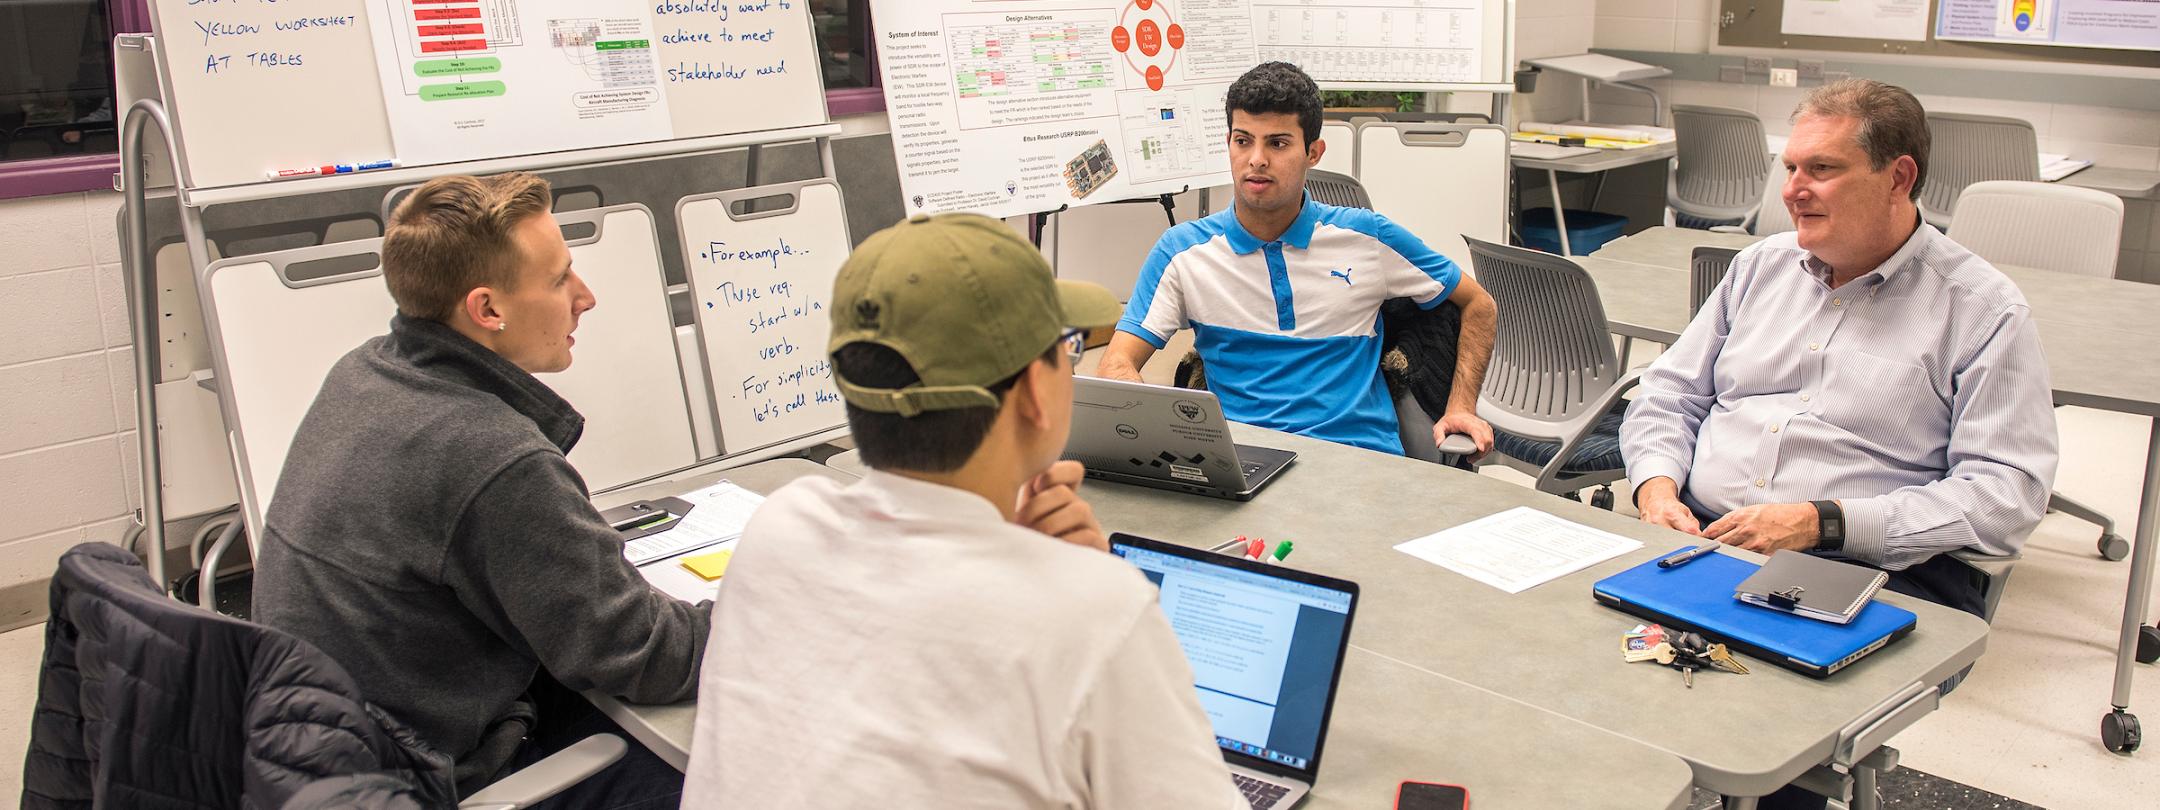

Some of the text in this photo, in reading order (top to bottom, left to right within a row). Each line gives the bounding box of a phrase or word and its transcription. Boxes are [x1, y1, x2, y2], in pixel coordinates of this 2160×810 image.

[656, 0, 790, 21] absolutely want to
[1006, 15, 1023, 23] Design
[194, 15, 356, 46] YELLOW WORKSHEET
[662, 27, 775, 44] achieve to meet
[888, 31, 910, 39] System
[206, 52, 303, 74] AT TABLES
[667, 60, 787, 82] stakeholder need
[710, 241, 735, 263] For
[769, 281, 793, 298] req.
[748, 306, 788, 333] start
[813, 301, 822, 310] a
[759, 336, 800, 360] verb.
[742, 359, 833, 400] For simplicity
[753, 398, 779, 422] let's
[785, 393, 807, 413] call
